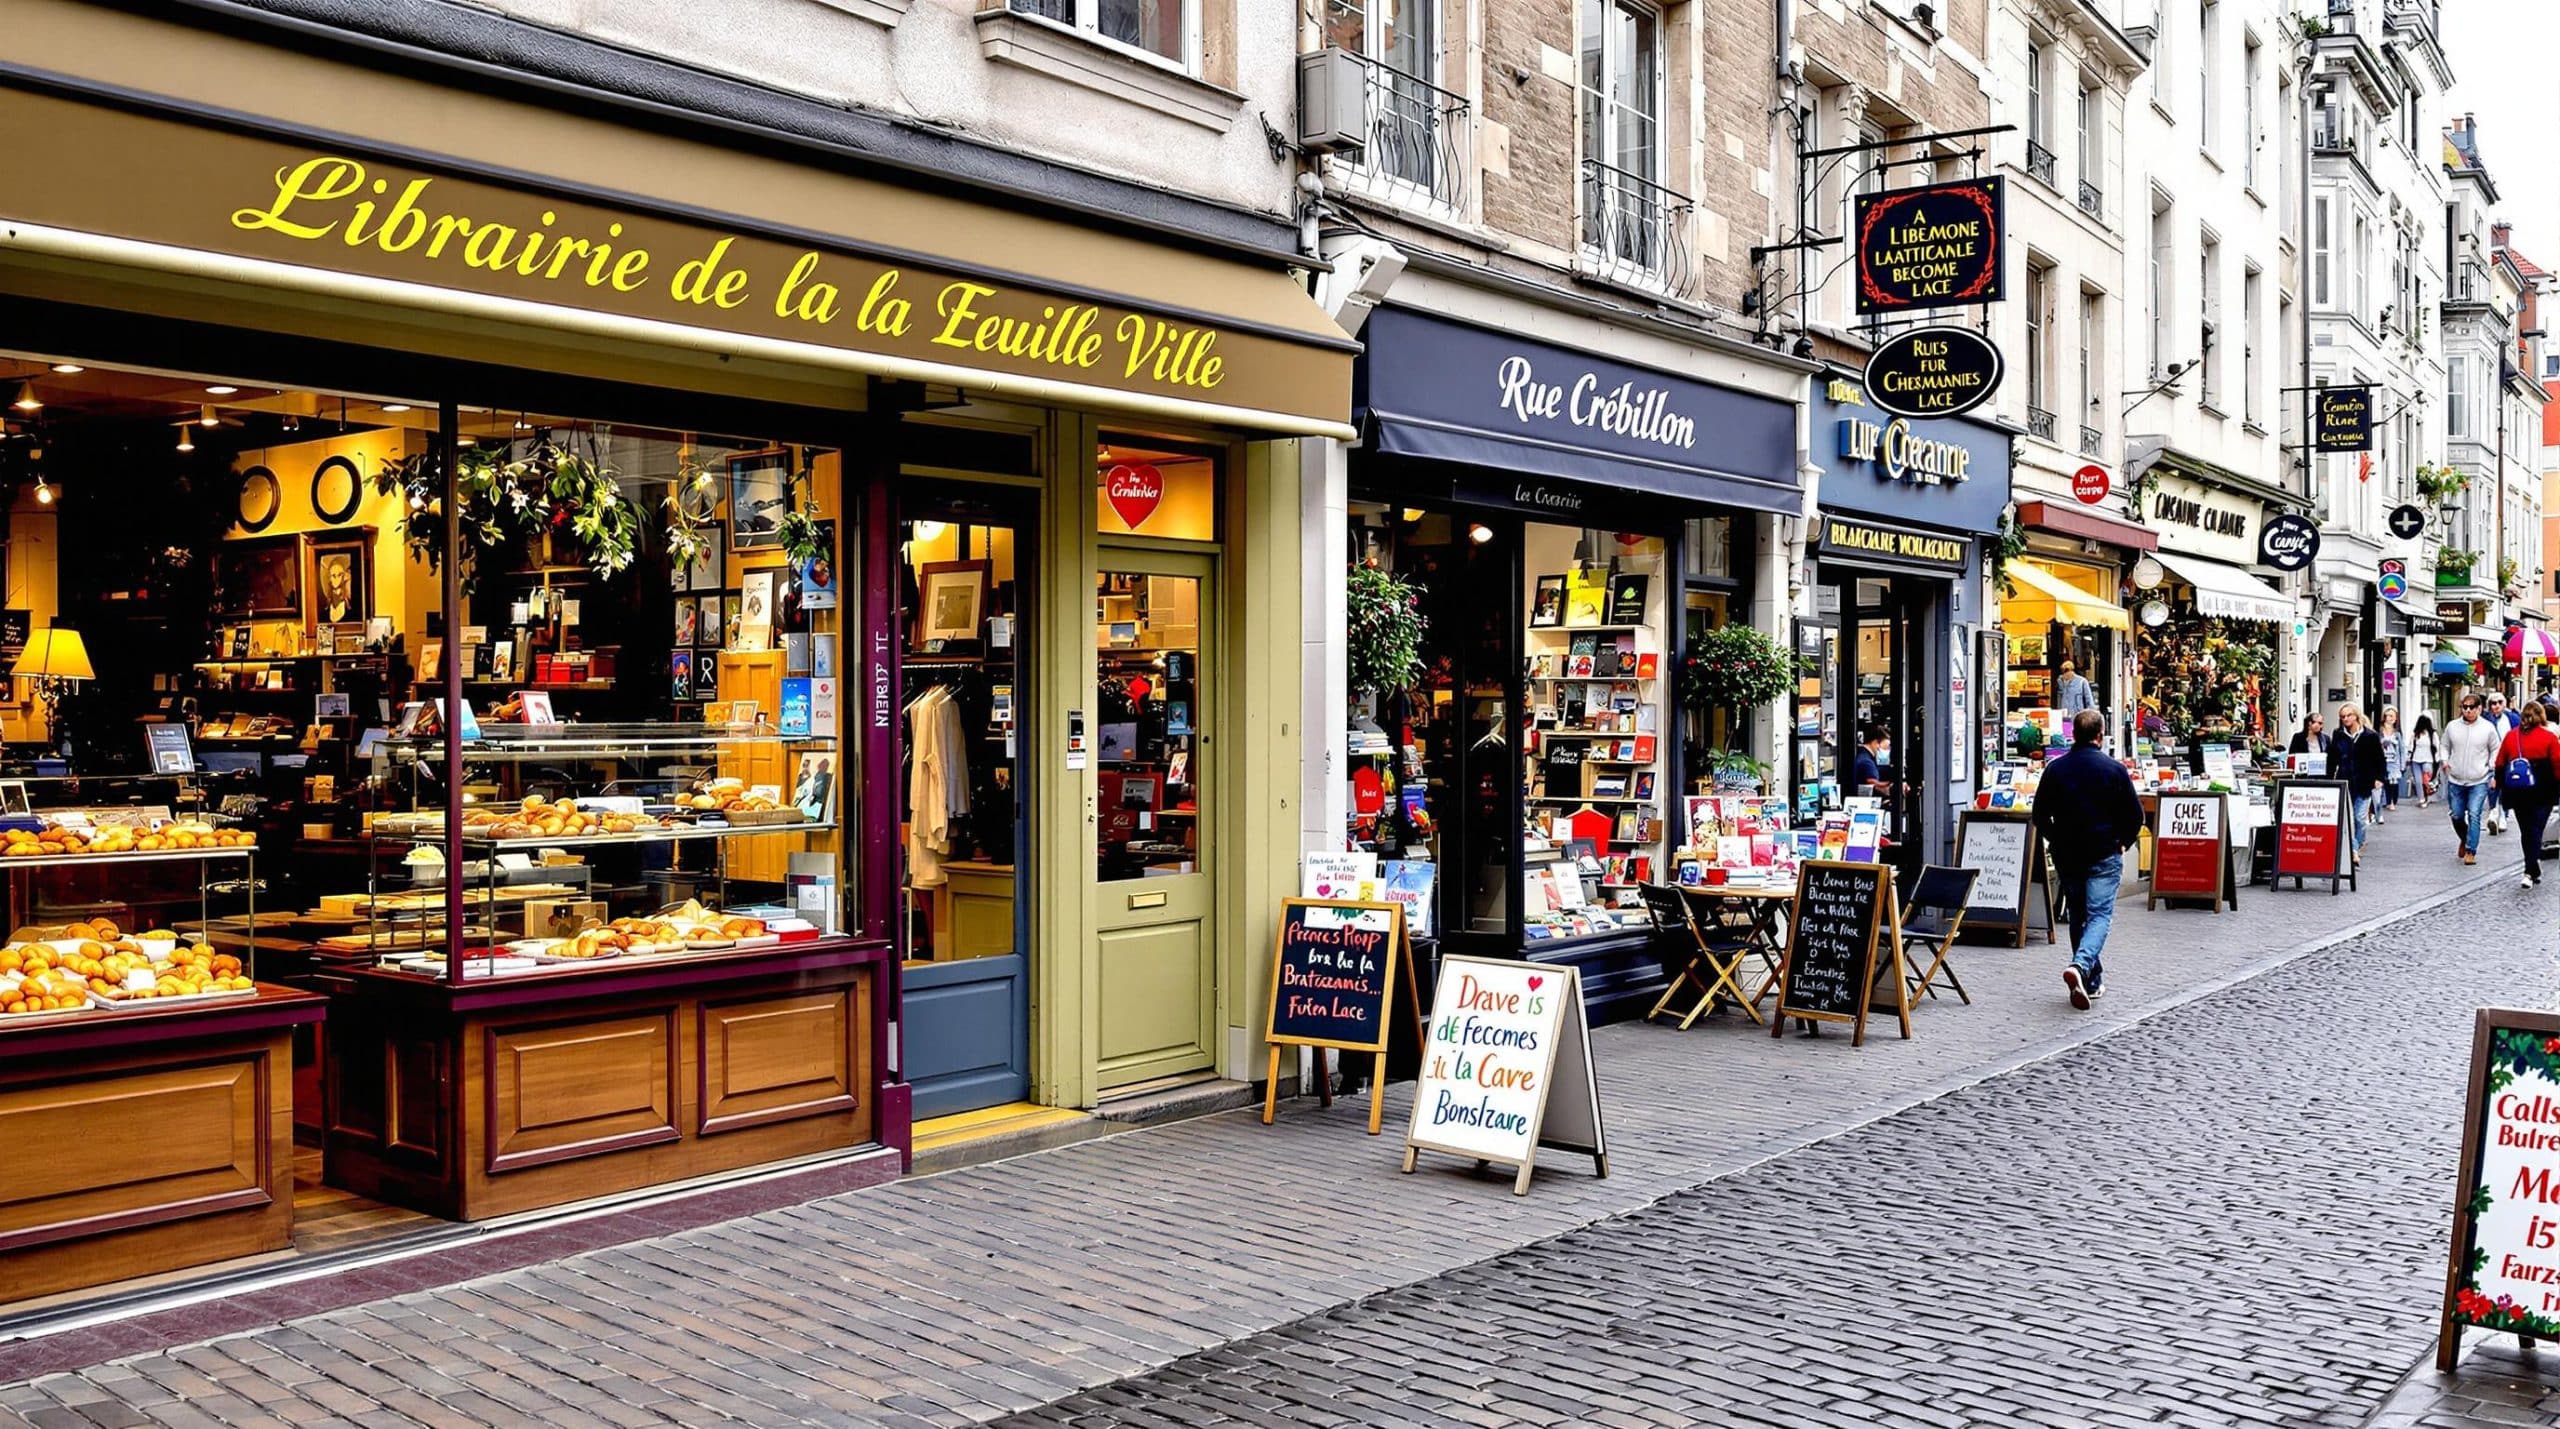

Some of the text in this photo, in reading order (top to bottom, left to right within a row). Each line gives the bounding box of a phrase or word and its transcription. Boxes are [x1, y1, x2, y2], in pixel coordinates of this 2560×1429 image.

[1913, 209, 1926, 225] A
[231, 156, 649, 292] Librairie
[671, 237, 750, 309] de
[775, 252, 841, 324] la
[856, 270, 912, 338] la
[1116, 314, 1225, 388] Ville
[1892, 261, 1959, 283] BECOME
[1912, 279, 1952, 298] LACE
[1498, 355, 1697, 449] Rue Crébillon
[1919, 392, 1954, 408] LACE
[1457, 974, 1520, 1014] Drave
